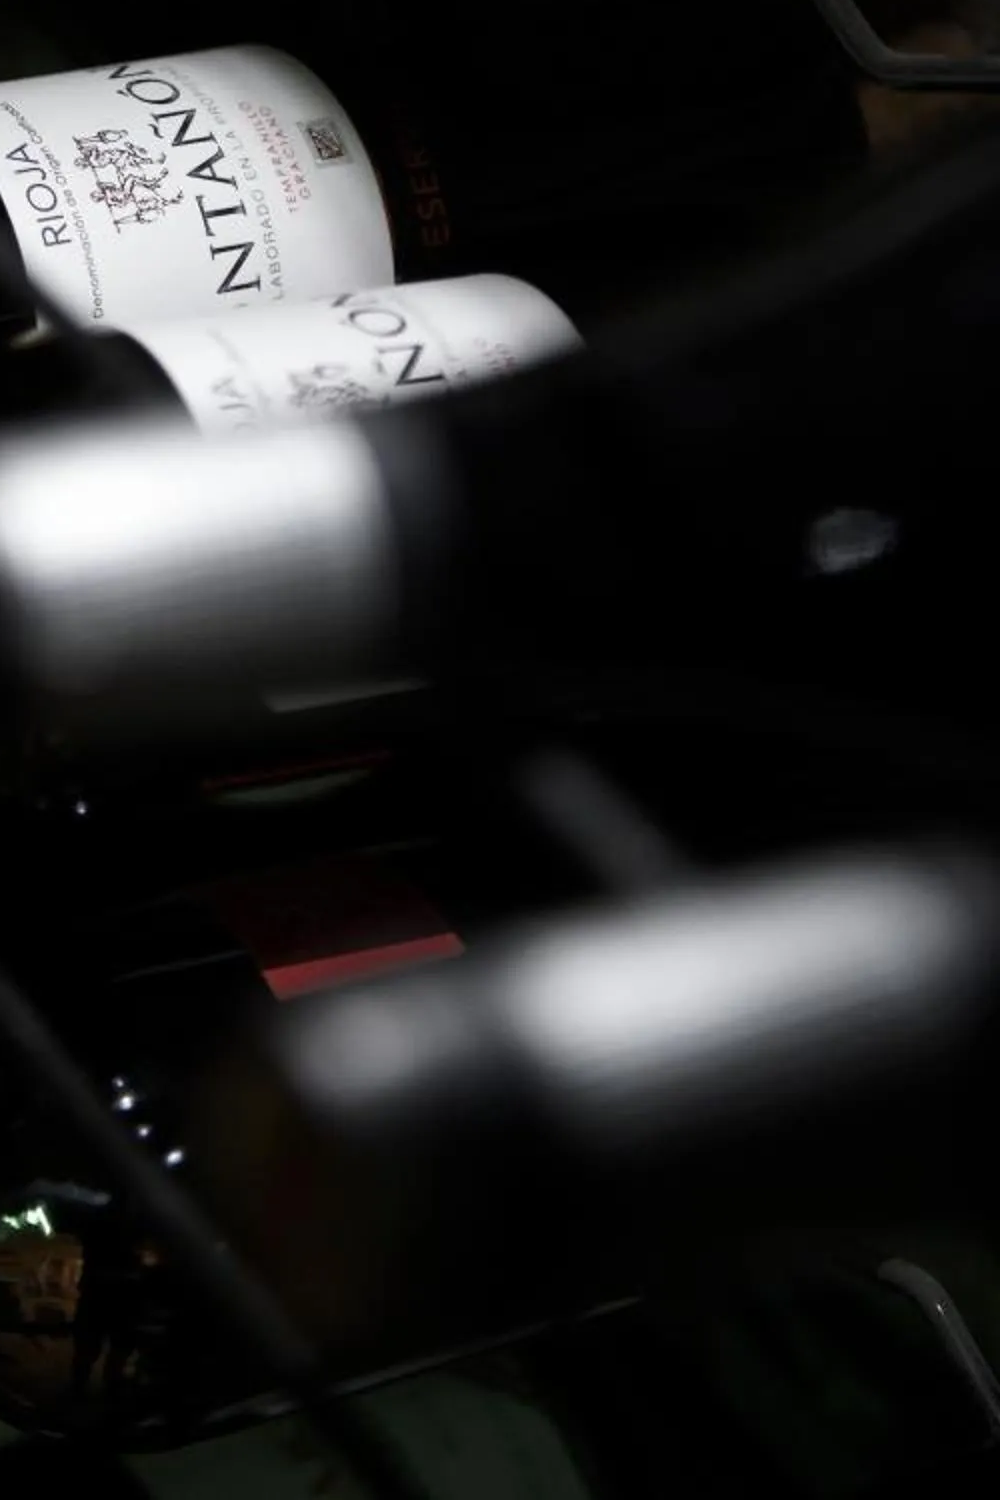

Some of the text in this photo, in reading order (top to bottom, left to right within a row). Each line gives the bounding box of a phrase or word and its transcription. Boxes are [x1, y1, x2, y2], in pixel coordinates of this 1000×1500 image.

[5, 143, 73, 247] RIOJA
[108, 65, 262, 295] NTAÑÓN
[238, 100, 301, 214] TEMPRANILLO
[238, 156, 258, 182] EN
[258, 105, 312, 200] GRACIANO
[252, 188, 284, 302] LABORADO
